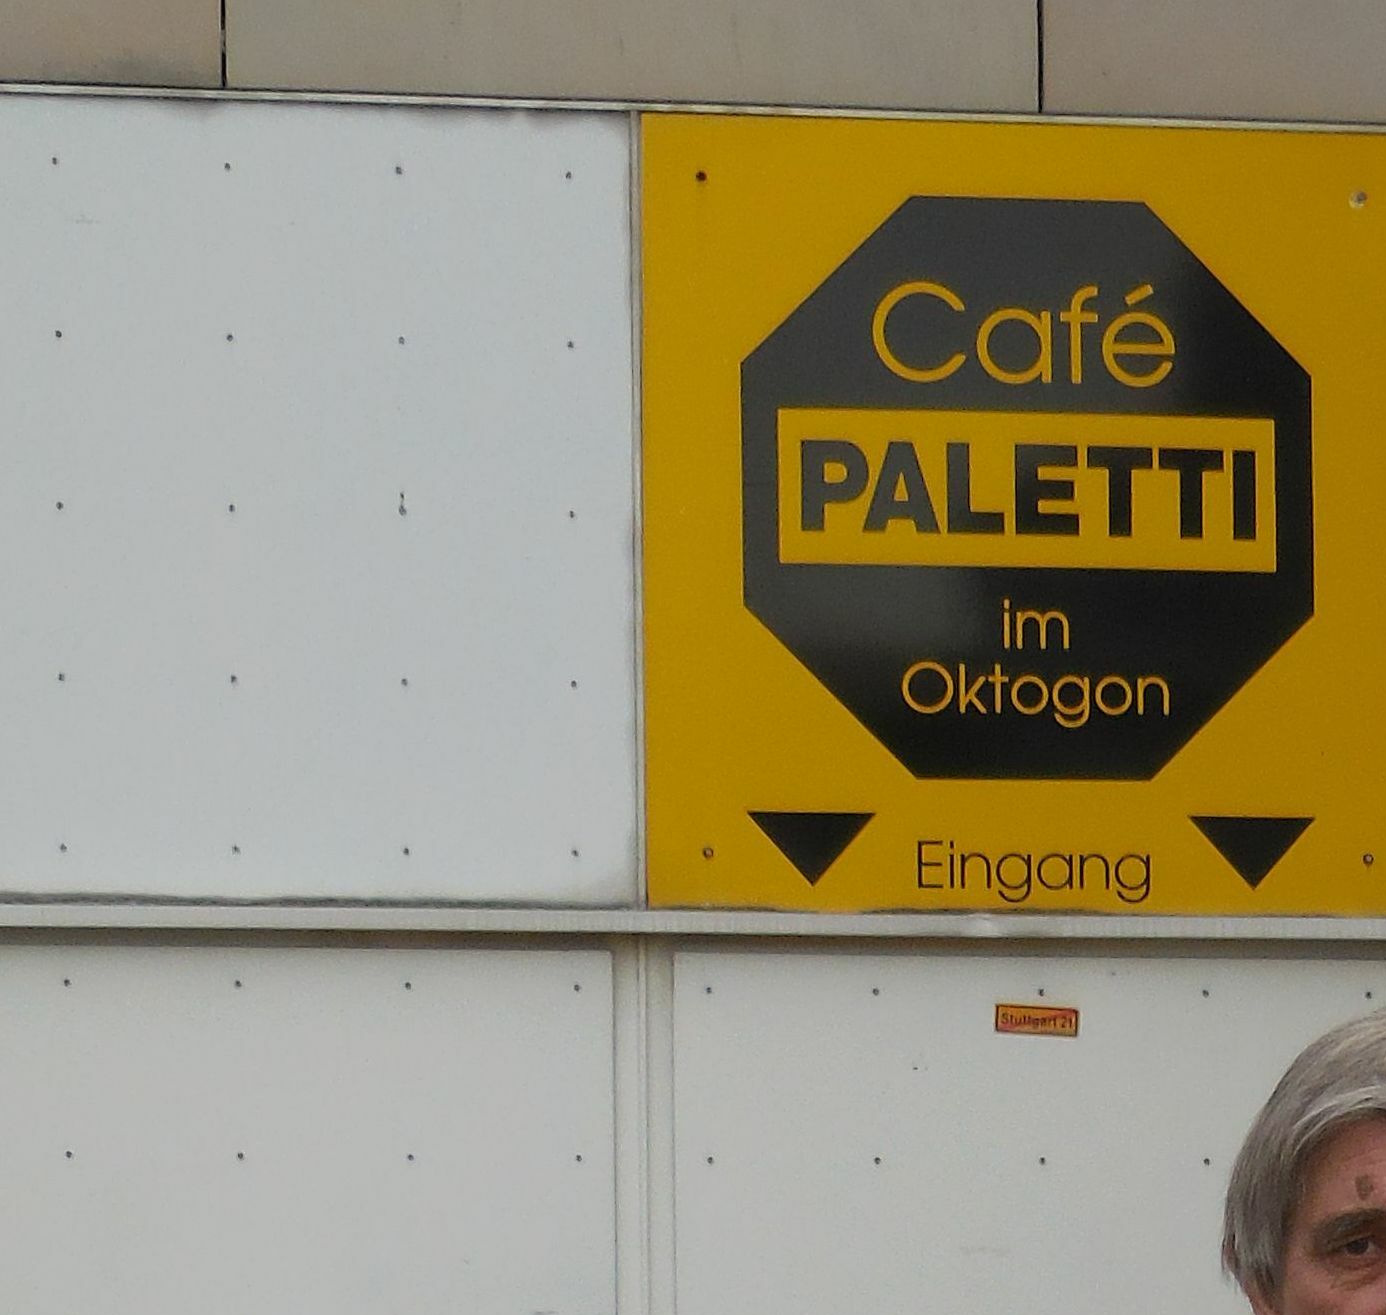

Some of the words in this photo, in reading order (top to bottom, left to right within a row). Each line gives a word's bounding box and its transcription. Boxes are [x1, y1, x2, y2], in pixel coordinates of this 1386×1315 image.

[872, 280, 1176, 388] Café
[800, 439, 1257, 542] PALETTI
[1002, 597, 1070, 650] im
[900, 659, 1170, 729] Oktogon
[917, 839, 1151, 904] Eingang
[1001, 1012, 1057, 1029] Stuttgart
